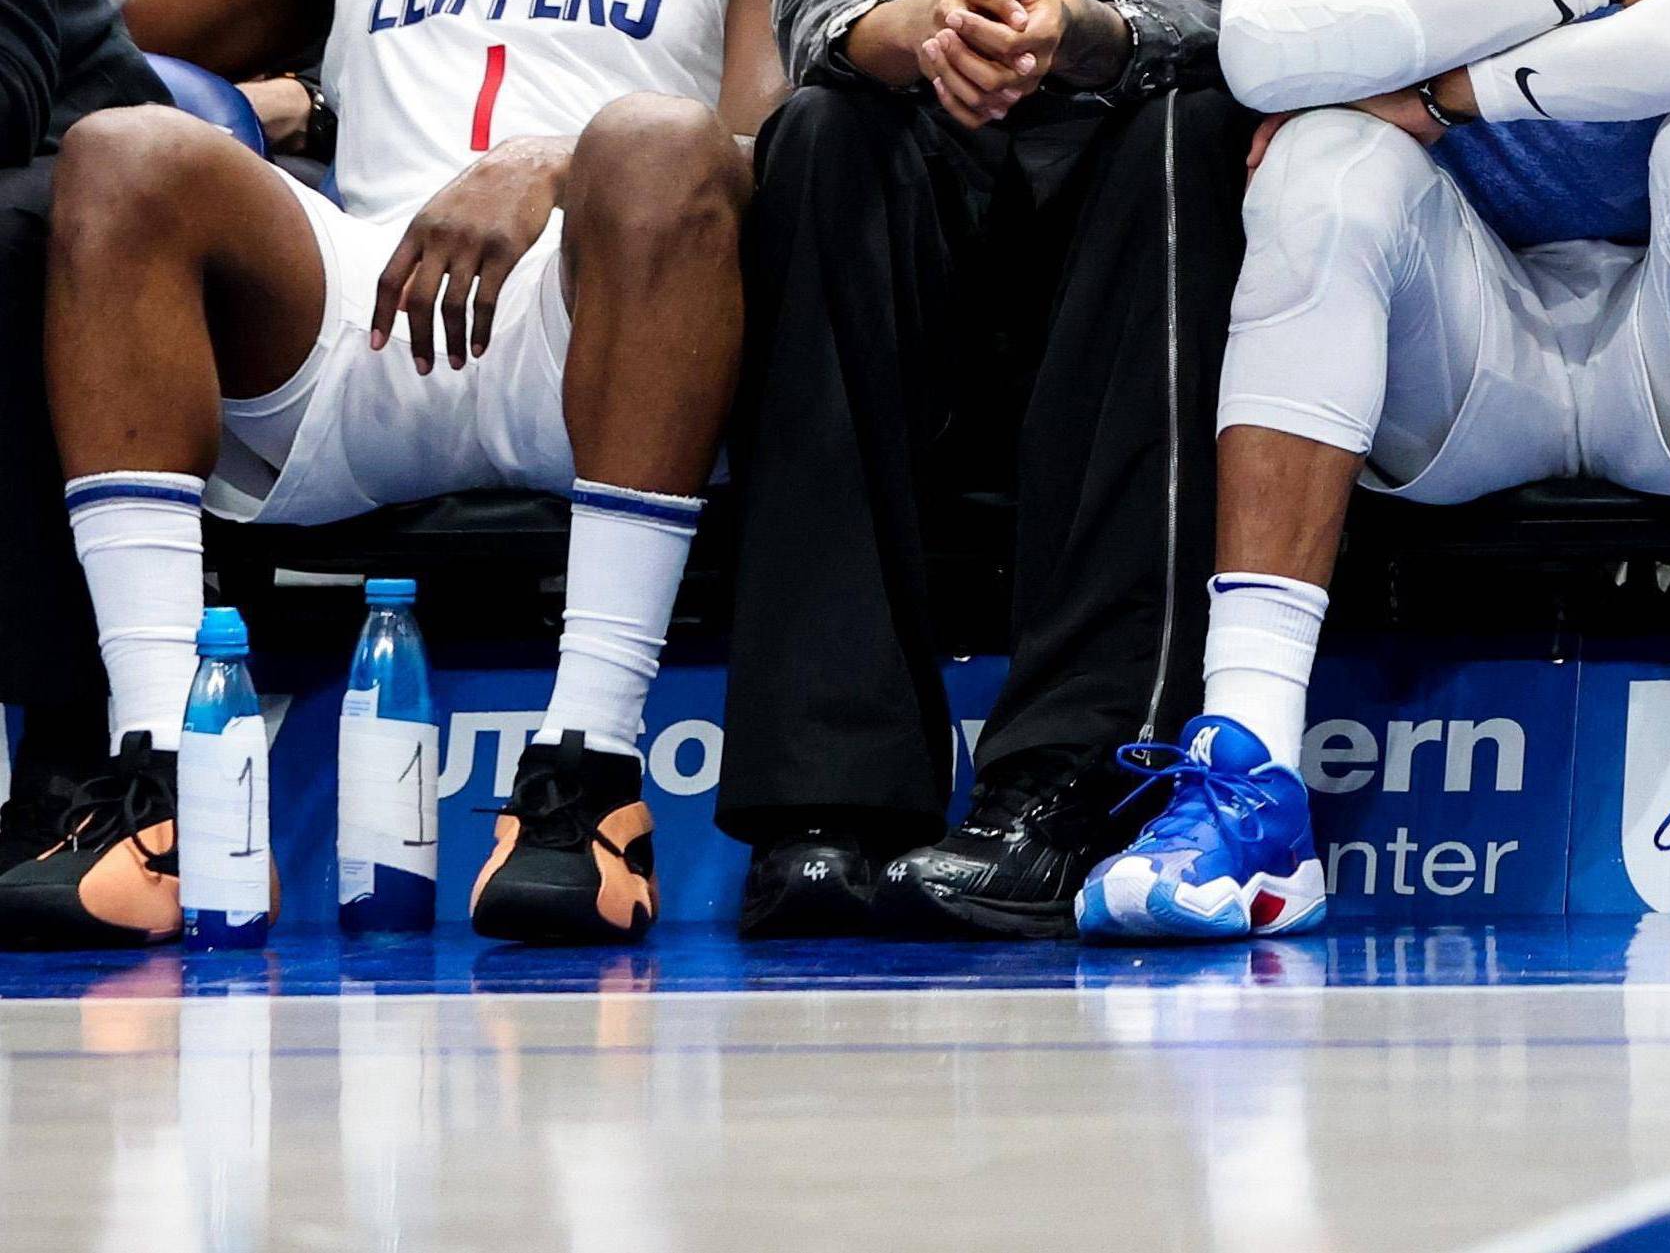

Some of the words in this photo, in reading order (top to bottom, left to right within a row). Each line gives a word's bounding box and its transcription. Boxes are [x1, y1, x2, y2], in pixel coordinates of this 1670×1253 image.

[471, 44, 505, 151] 1
[1300, 718, 1526, 794] ern
[1327, 827, 1519, 896] nter
